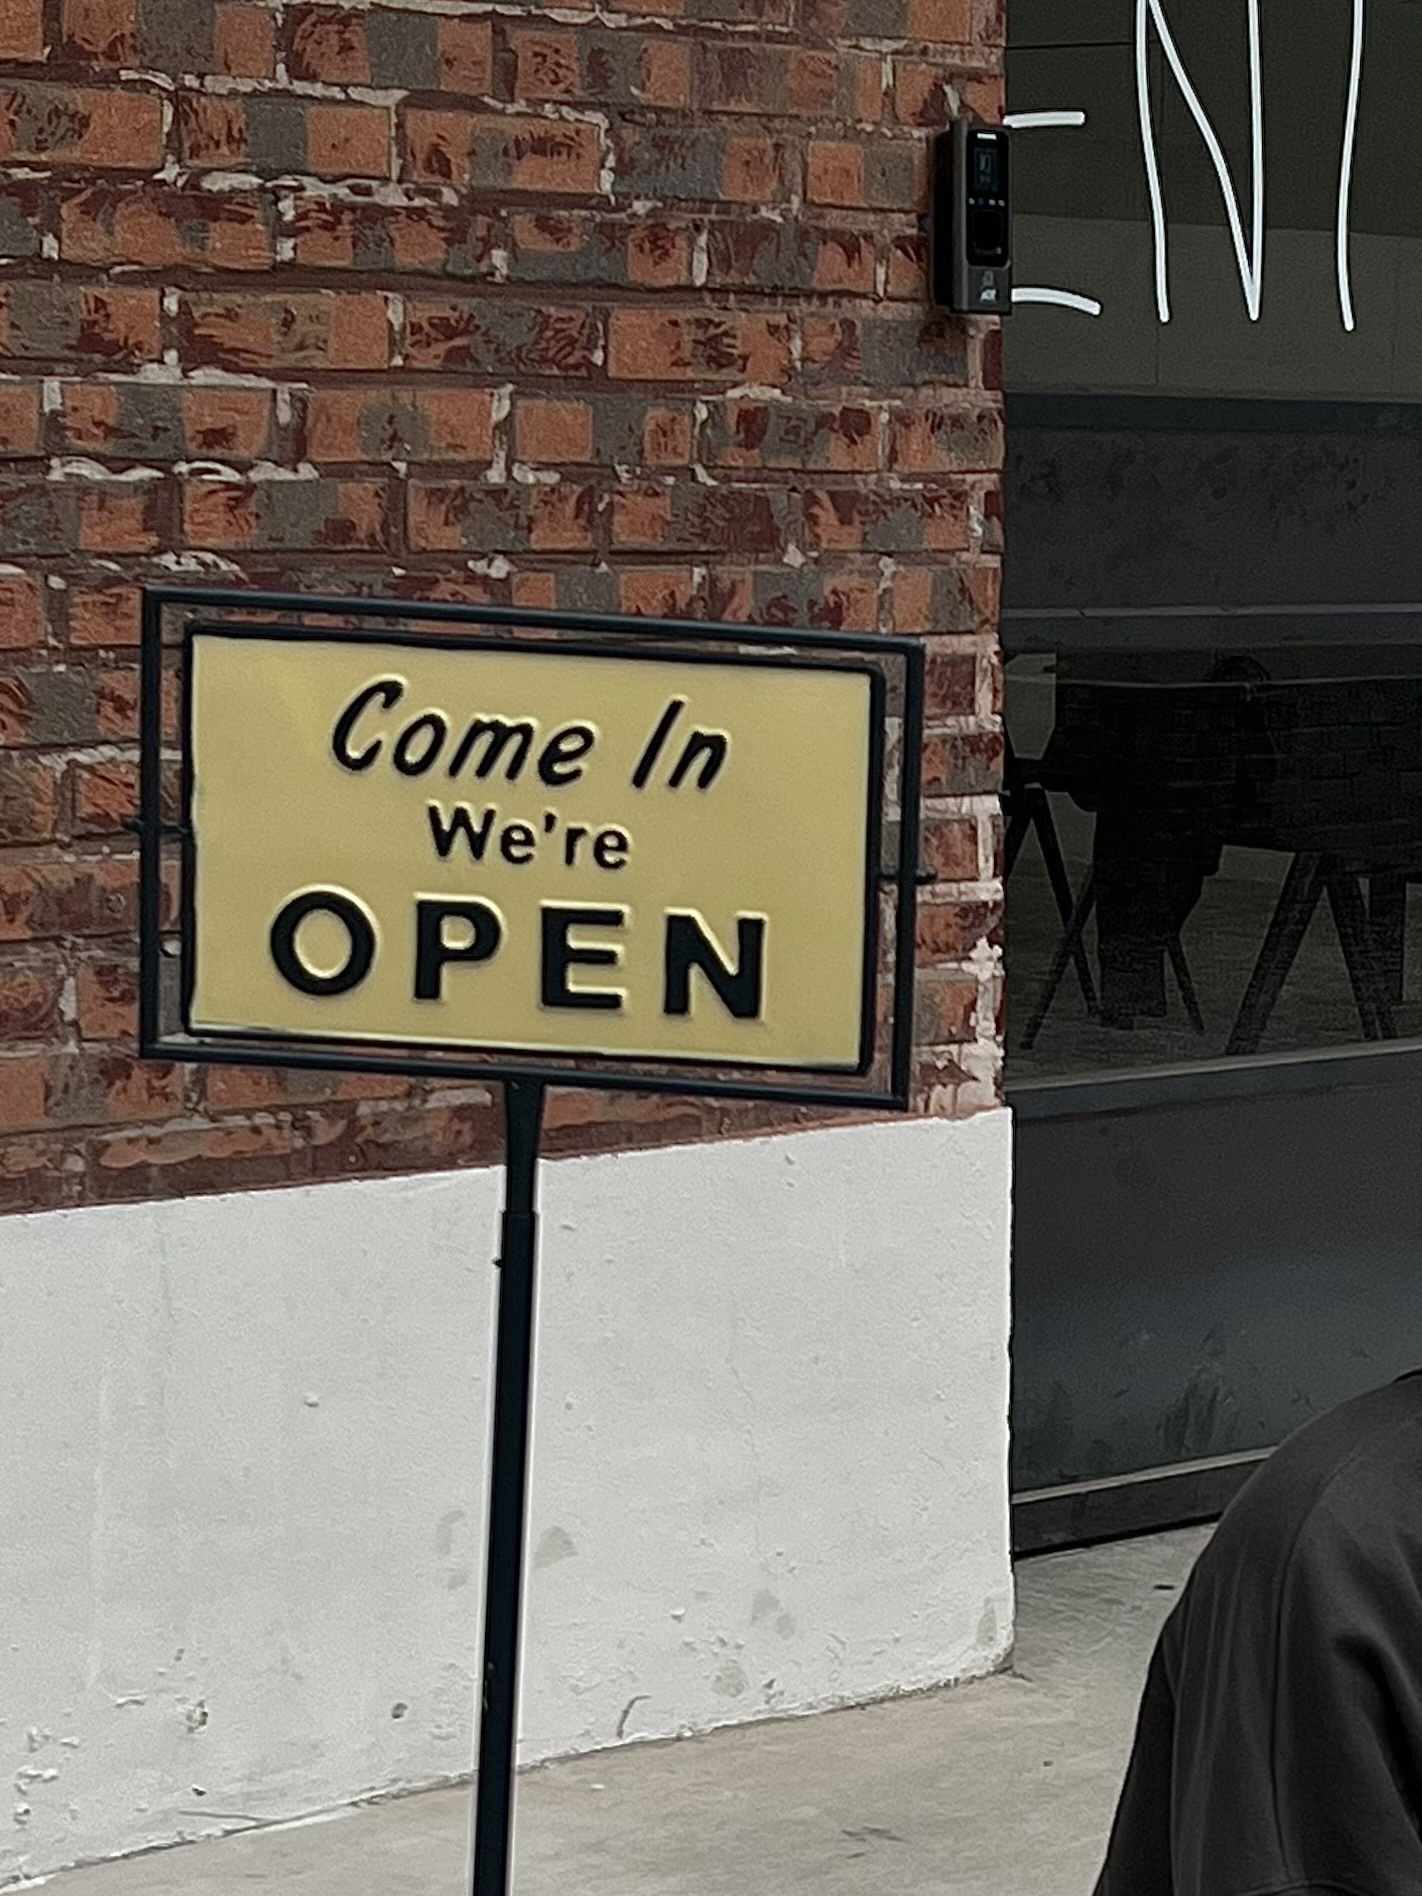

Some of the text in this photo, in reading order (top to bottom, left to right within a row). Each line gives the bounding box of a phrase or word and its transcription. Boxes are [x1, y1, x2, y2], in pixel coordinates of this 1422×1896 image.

[332, 677, 729, 790] Come In
[427, 803, 631, 871] We're
[269, 889, 767, 1020] OPEN
